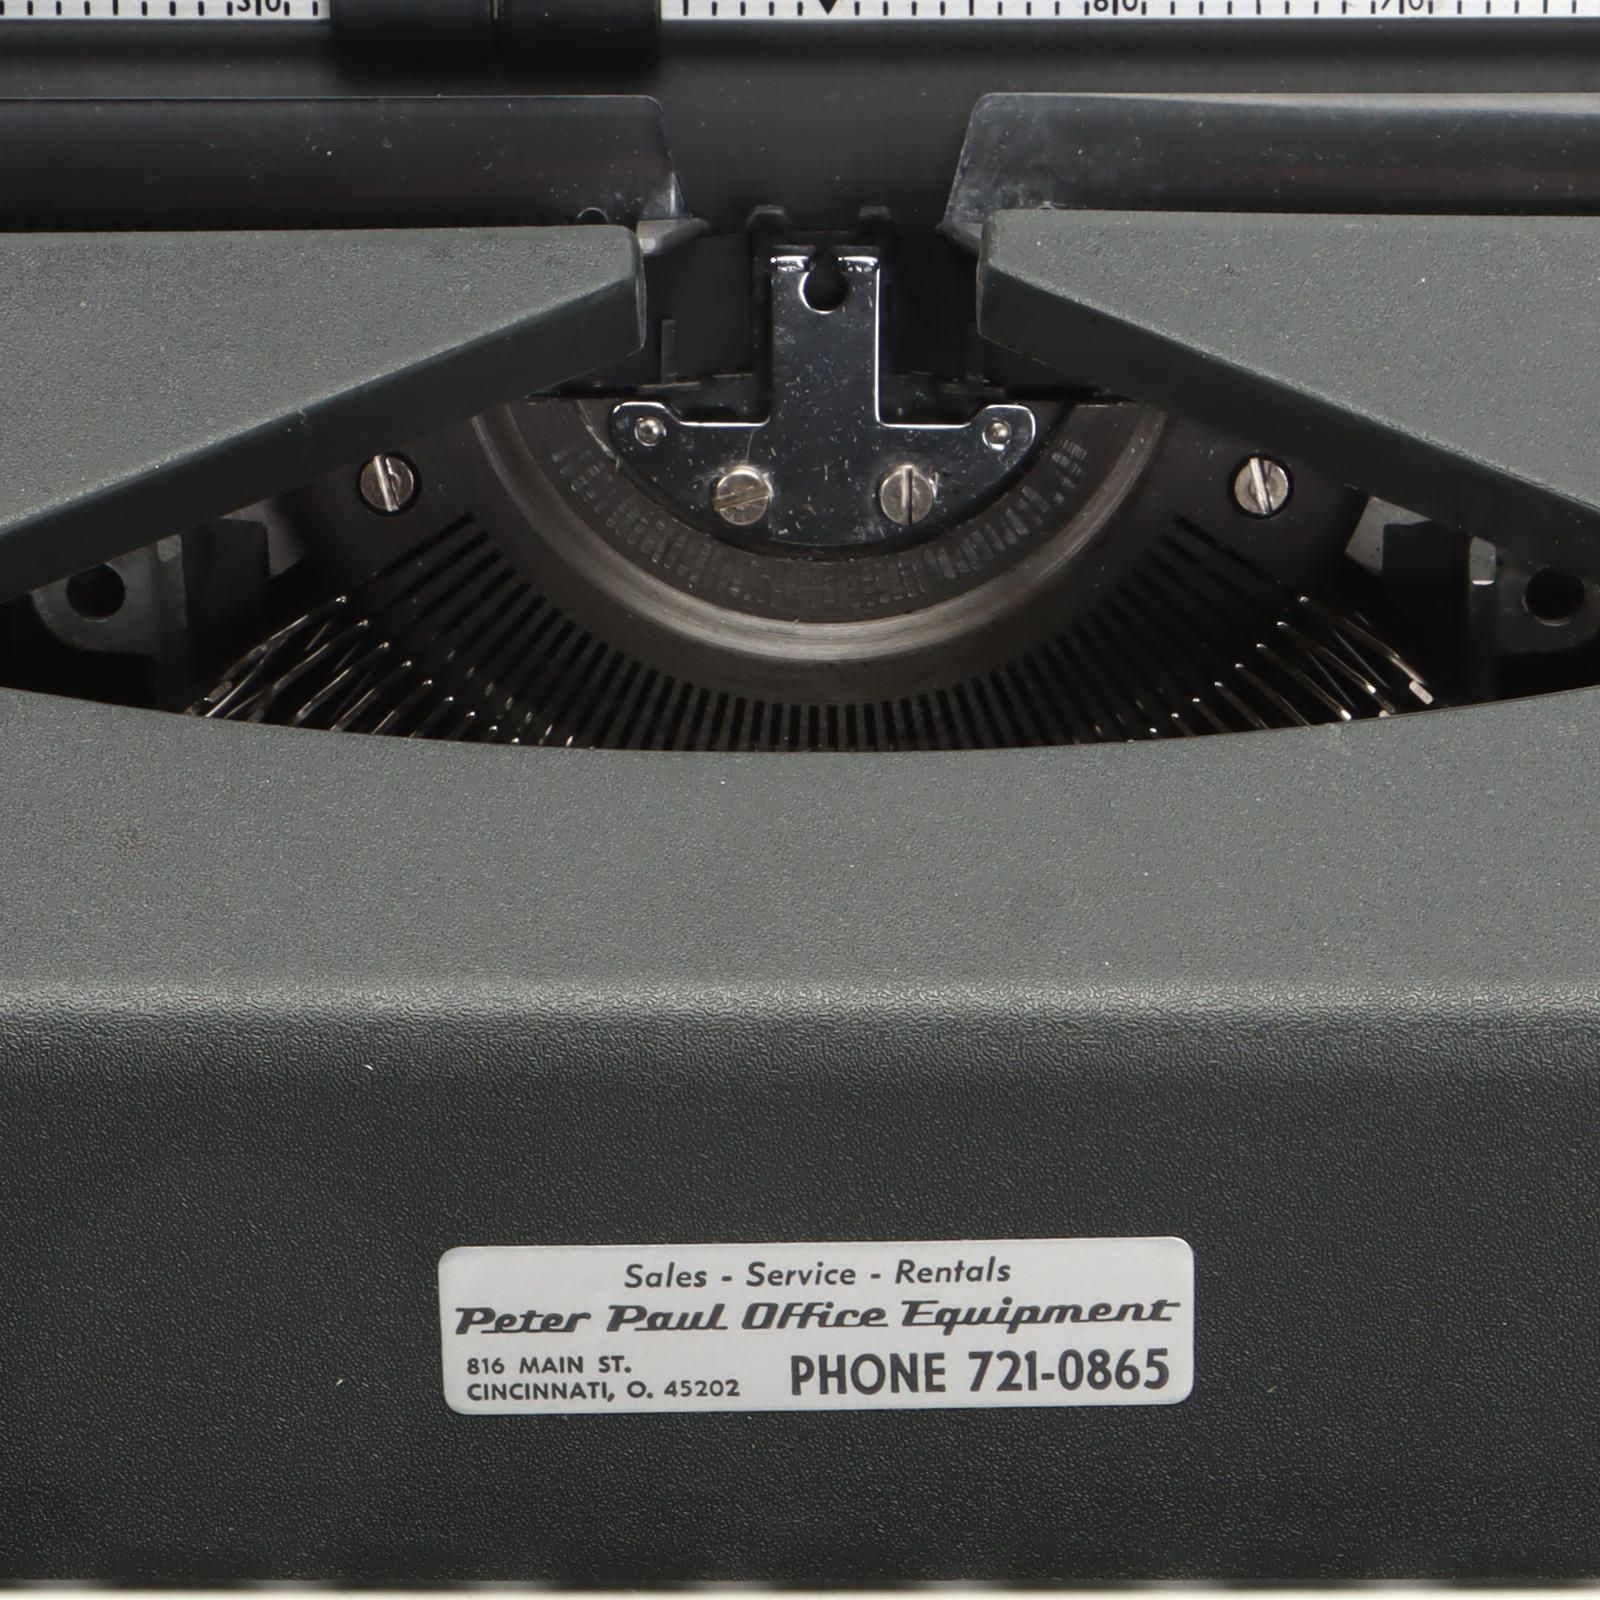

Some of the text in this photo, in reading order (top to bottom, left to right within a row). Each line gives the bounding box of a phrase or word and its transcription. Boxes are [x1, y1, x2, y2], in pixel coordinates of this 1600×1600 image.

[624, 1261, 707, 1289] Sales
[746, 1261, 856, 1287] Service
[895, 1255, 1011, 1284] Rentals
[455, 1296, 1179, 1336] Peter Paul Office Equipment
[467, 1355, 632, 1375] 816 MAIN ST.
[790, 1347, 1170, 1396] PHONE 721-0865
[466, 1378, 740, 1403] CINCINNATI, O. 45202
